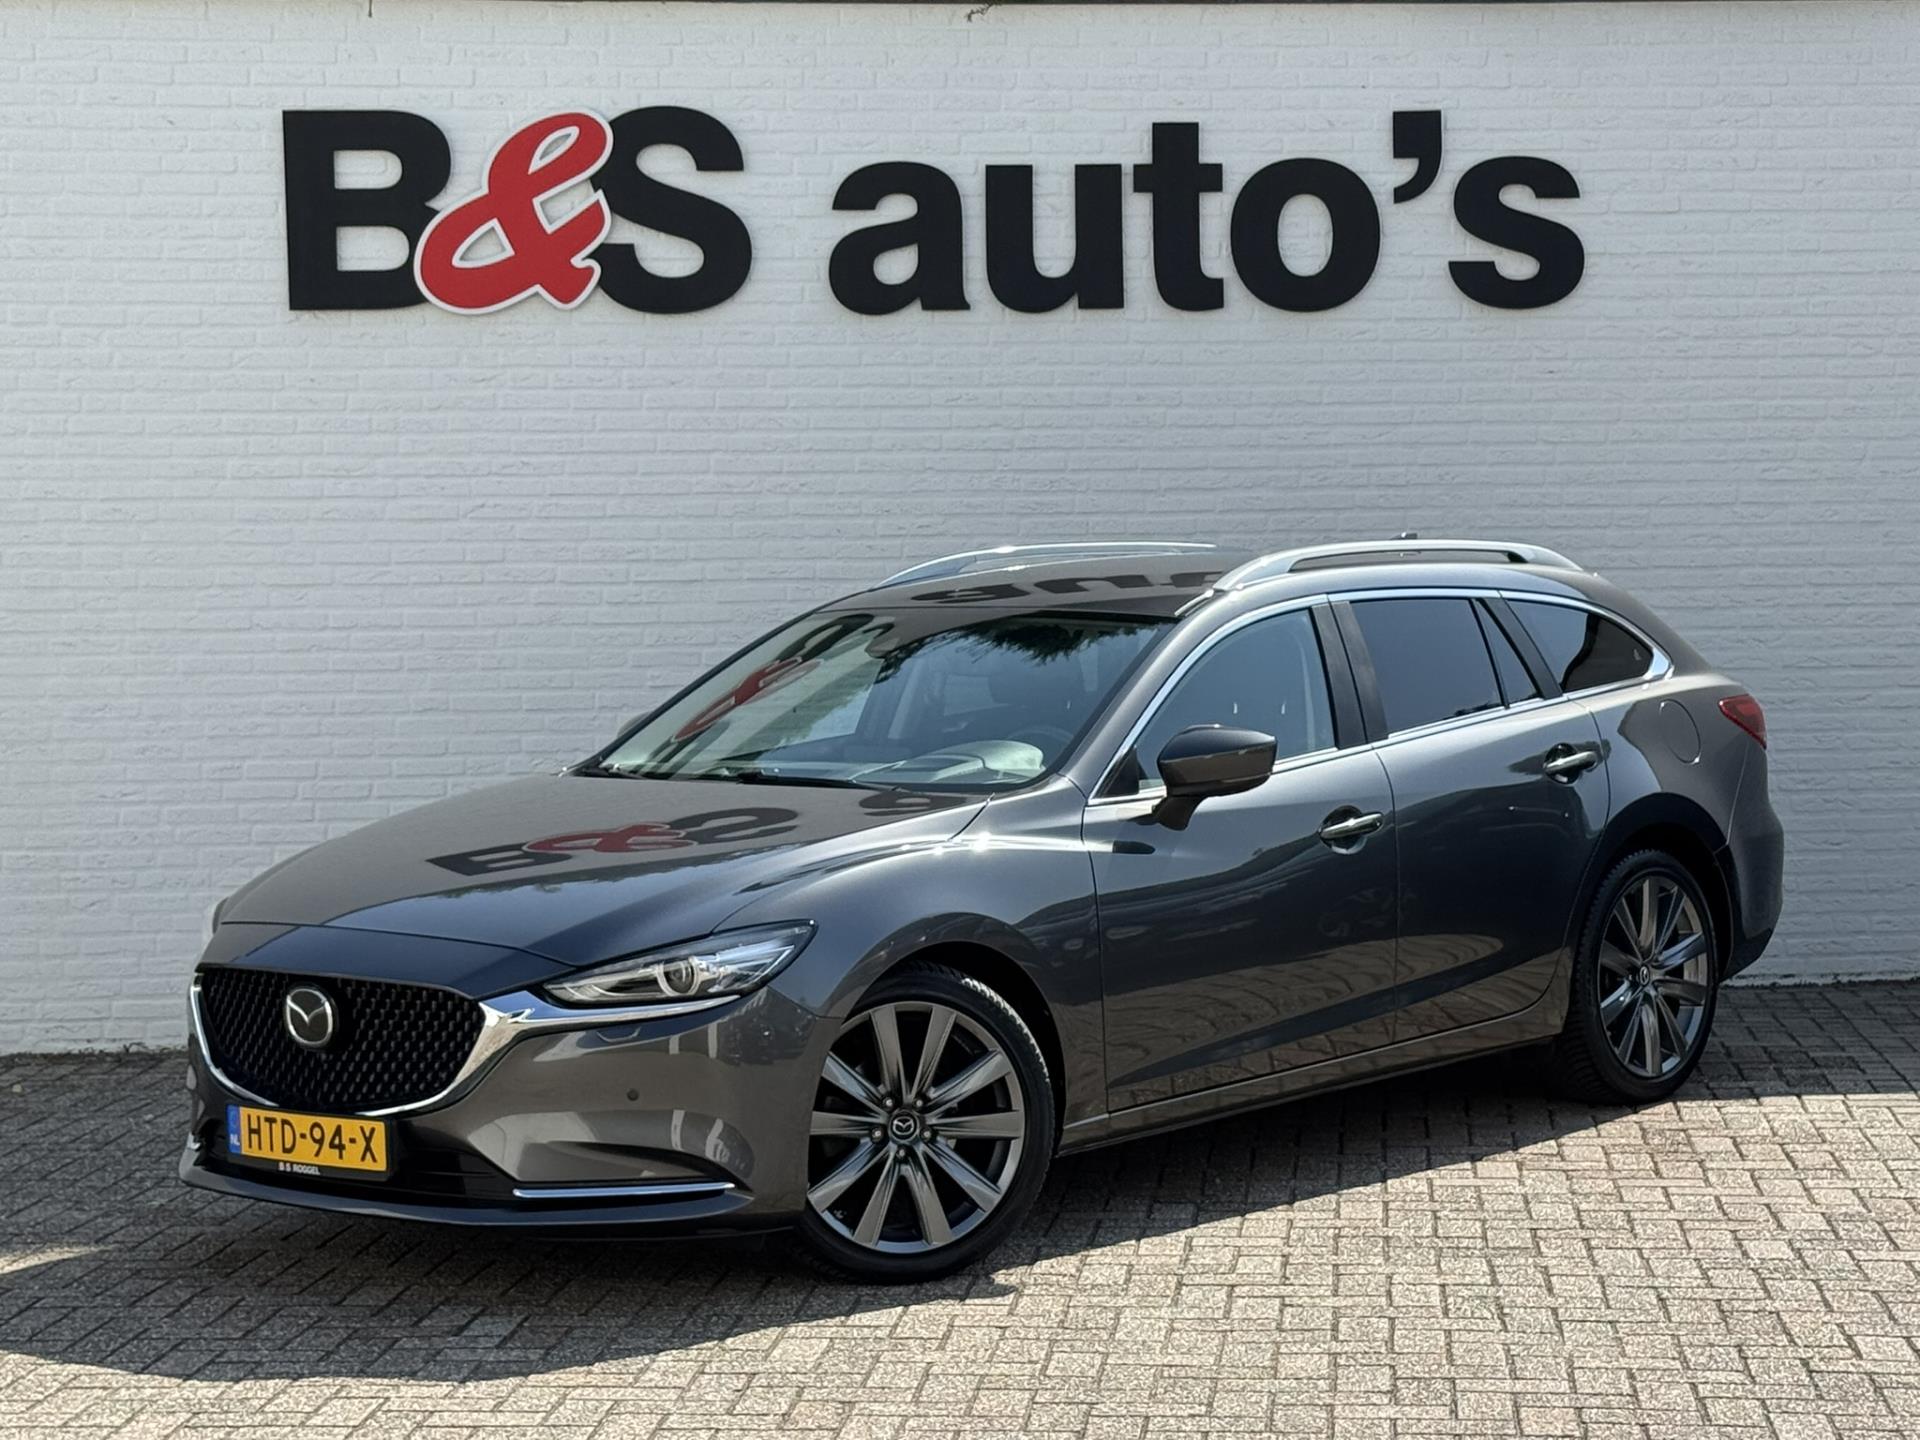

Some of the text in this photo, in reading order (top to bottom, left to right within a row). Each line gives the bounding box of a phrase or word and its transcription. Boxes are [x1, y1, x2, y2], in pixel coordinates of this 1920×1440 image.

[283, 106, 1585, 315] B&S auto's
[230, 1134, 241, 1146] NL
[247, 1113, 377, 1163] HTD-94-X
